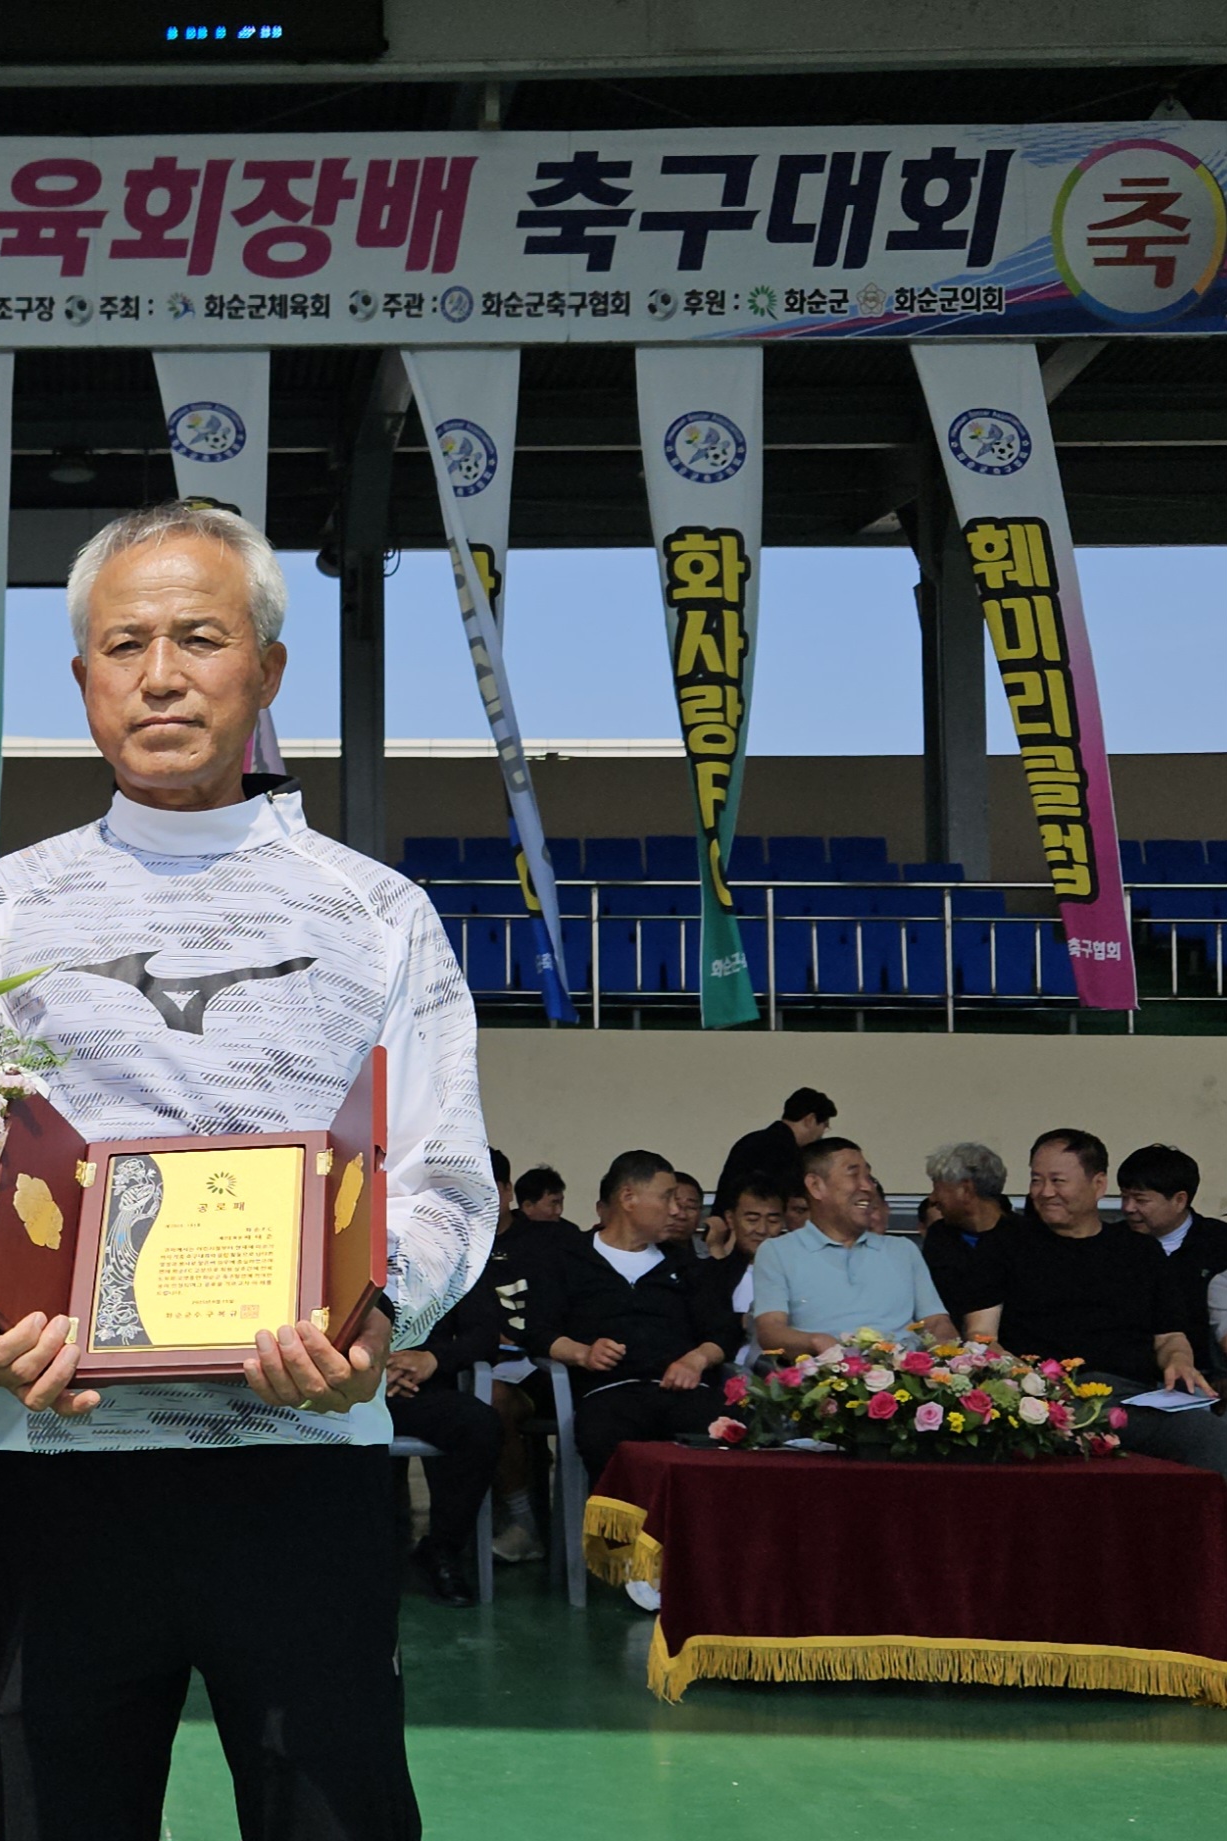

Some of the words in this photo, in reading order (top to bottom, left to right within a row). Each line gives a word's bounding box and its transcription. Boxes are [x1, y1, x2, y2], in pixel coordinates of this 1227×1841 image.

[515, 148, 1018, 273] 축구대회
[1086, 175, 1191, 290] 축
[99, 295, 140, 321] 주최
[204, 293, 330, 320] 화순군체육회
[382, 292, 425, 319] 주관
[481, 290, 631, 318] 화순군축구협회
[683, 288, 726, 316] 후원
[784, 287, 849, 315] 화순군
[894, 286, 1005, 314] 화순군의회
